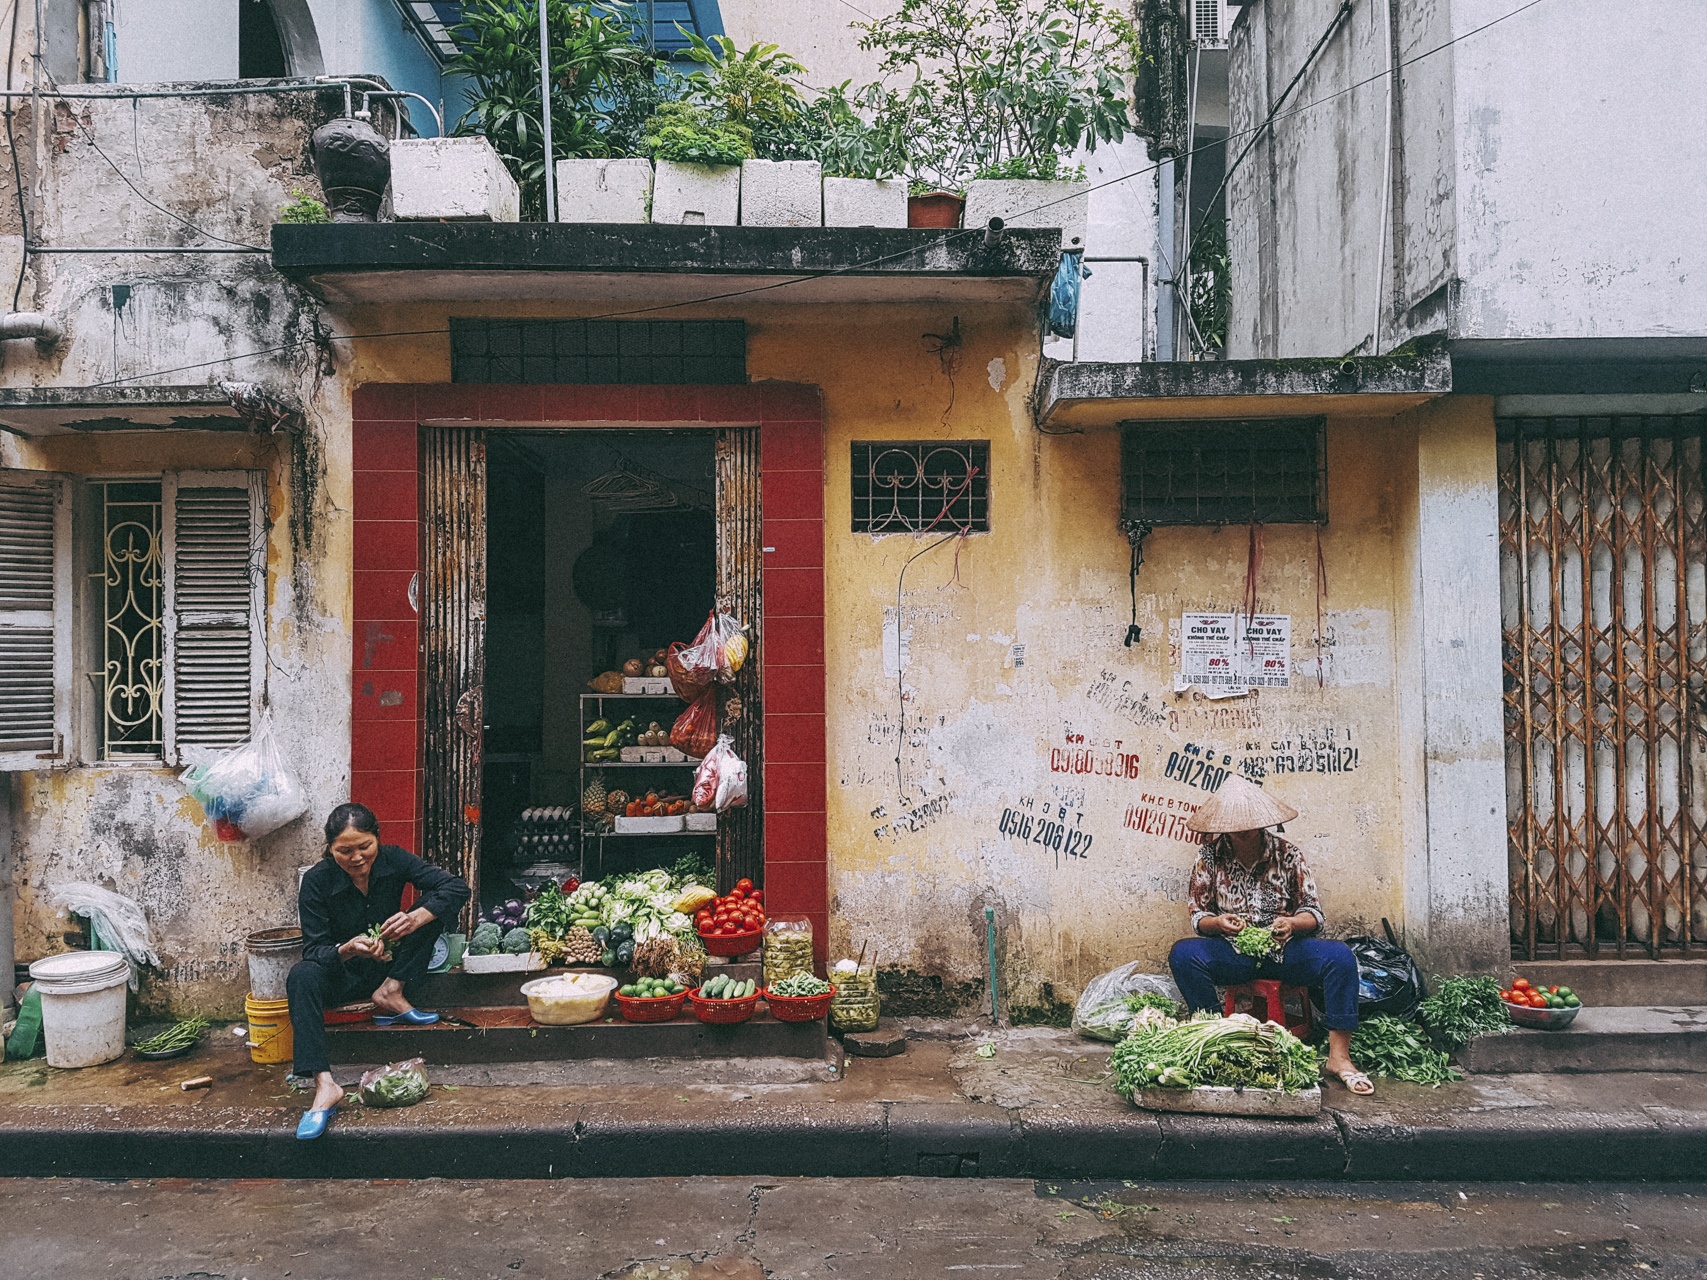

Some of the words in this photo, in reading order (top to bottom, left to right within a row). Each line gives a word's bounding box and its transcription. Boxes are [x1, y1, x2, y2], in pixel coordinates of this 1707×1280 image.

[1191, 626, 1208, 634] CHO
[1141, 793, 1155, 804] KH
[1167, 799, 1174, 808] B
[1178, 801, 1202, 813] TON
